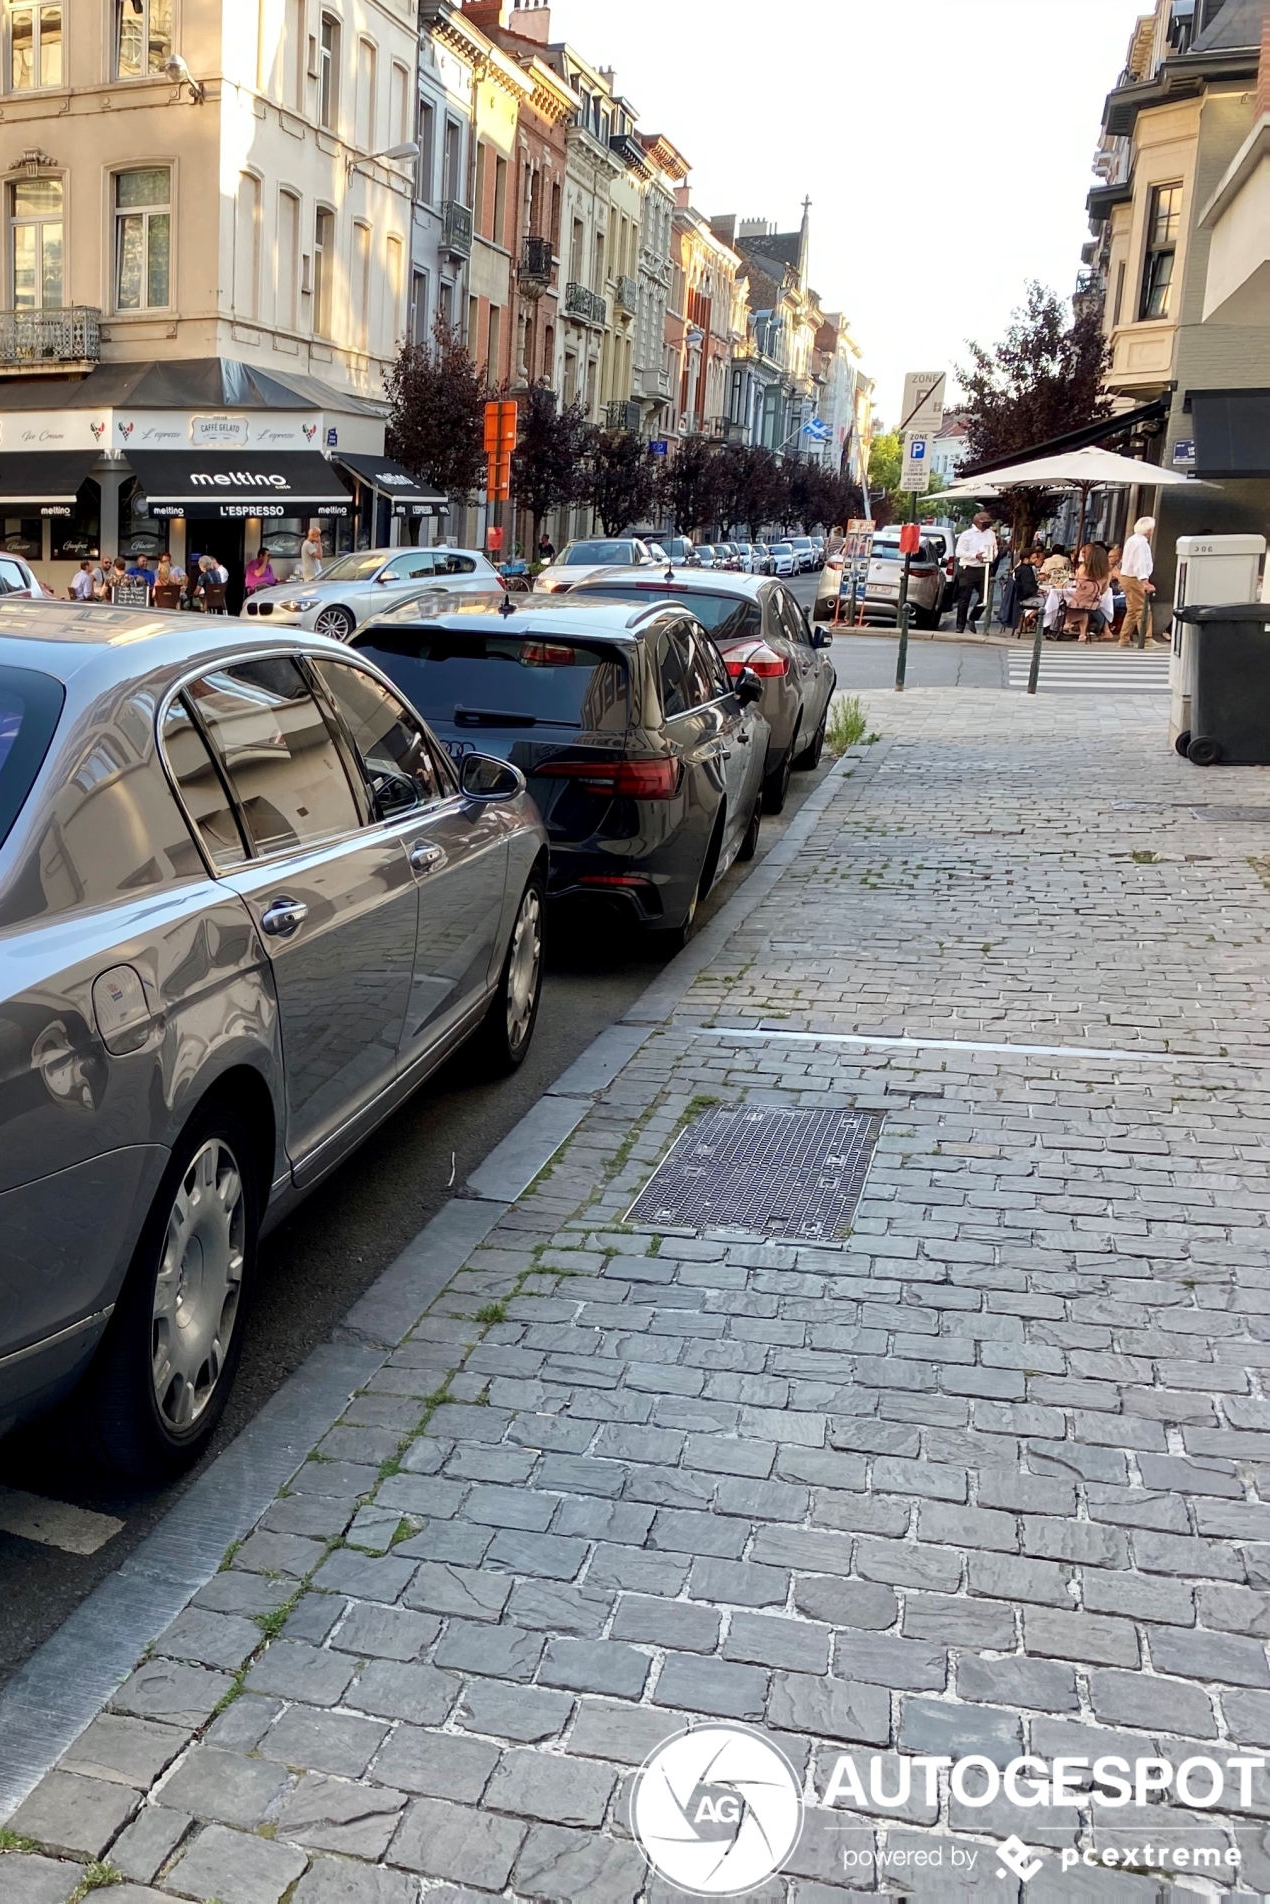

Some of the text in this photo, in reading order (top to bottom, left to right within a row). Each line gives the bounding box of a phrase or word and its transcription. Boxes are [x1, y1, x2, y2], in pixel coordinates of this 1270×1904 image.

[912, 374, 939, 384] ZONE
[219, 424, 240, 433] GELATO
[22, 430, 64, 441] Ice Cream
[190, 472, 287, 486] meltino
[40, 506, 71, 516] meltino
[154, 507, 184, 517] meltino
[220, 506, 284, 516] L'ESPRESSO
[318, 506, 348, 516] meltino
